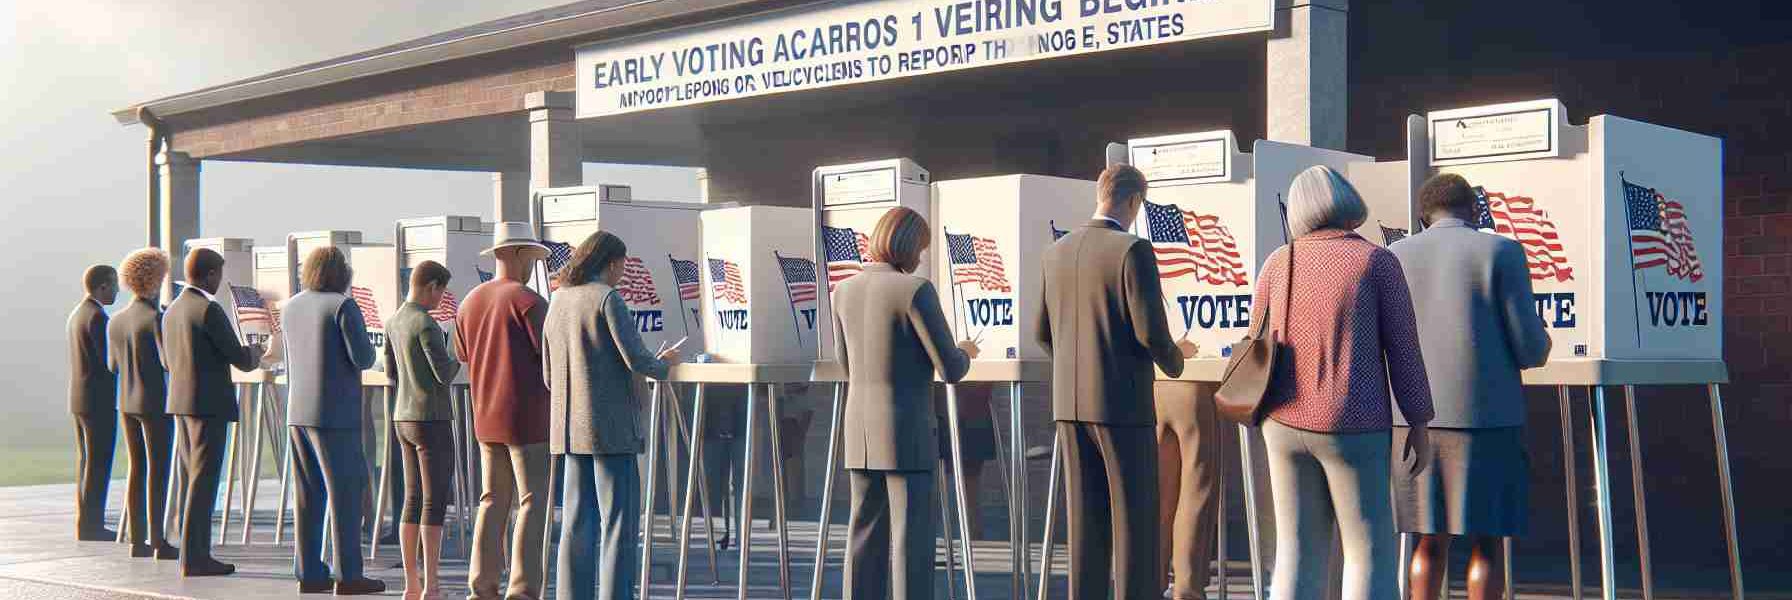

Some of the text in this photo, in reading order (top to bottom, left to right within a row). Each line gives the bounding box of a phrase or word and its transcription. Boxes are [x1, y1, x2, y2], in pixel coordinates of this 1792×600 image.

[594, 52, 665, 89] EARLY
[672, 36, 765, 77] VOTING
[866, 54, 892, 77] TO
[1107, 13, 1184, 45] STATES
[966, 298, 1013, 327] VOTE
[1176, 293, 1252, 330] VOTE
[1535, 292, 1576, 329] TE
[1646, 291, 1709, 327] VOTE
